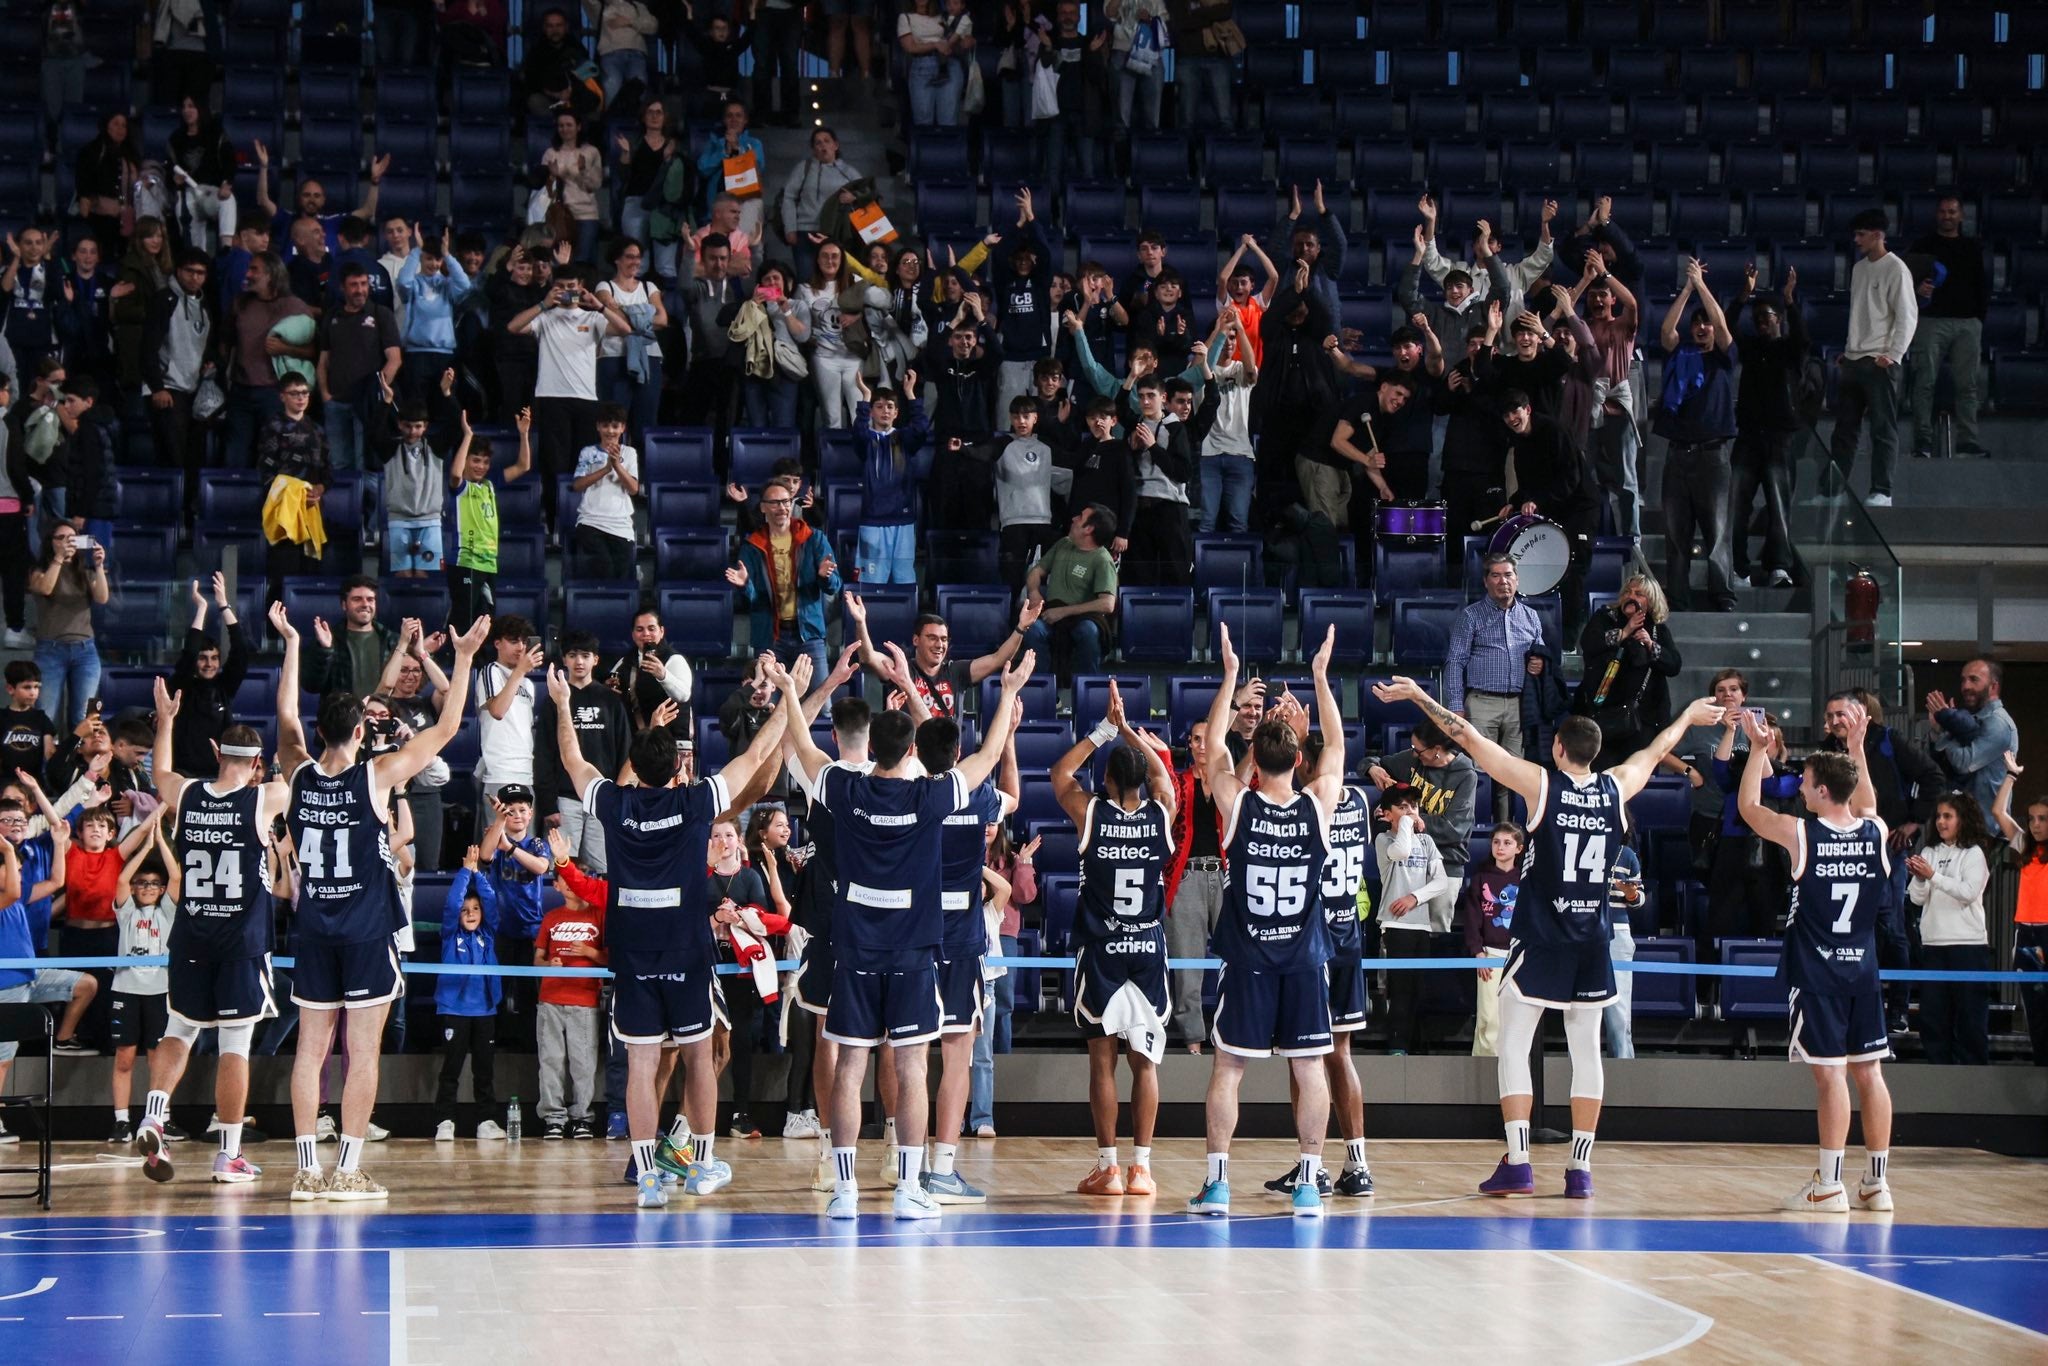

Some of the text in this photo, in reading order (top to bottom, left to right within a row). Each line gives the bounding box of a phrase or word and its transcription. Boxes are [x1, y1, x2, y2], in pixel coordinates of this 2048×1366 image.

[1561, 790, 1600, 808] SHELIST
[185, 810, 233, 825] HERMANSON
[1100, 824, 1141, 838] PARHAM
[1250, 818, 1297, 837] LOBACO
[1330, 828, 1365, 843] atec_
[185, 828, 245, 847] satec_
[298, 827, 353, 878] 41
[1097, 844, 1160, 861] satec_
[1247, 841, 1311, 859] satec_
[1563, 832, 1607, 883] 14
[1817, 842, 1863, 856] DUSCAK
[185, 849, 243, 899] 24
[1321, 845, 1364, 898] 35
[1815, 860, 1876, 878] satec_
[337, 883, 363, 893] RURAL
[1113, 868, 1144, 916] 5
[1246, 864, 1309, 917] 55
[219, 903, 243, 912] RURAL
[1831, 882, 1860, 933] 7
[1277, 925, 1302, 934] RURAL
